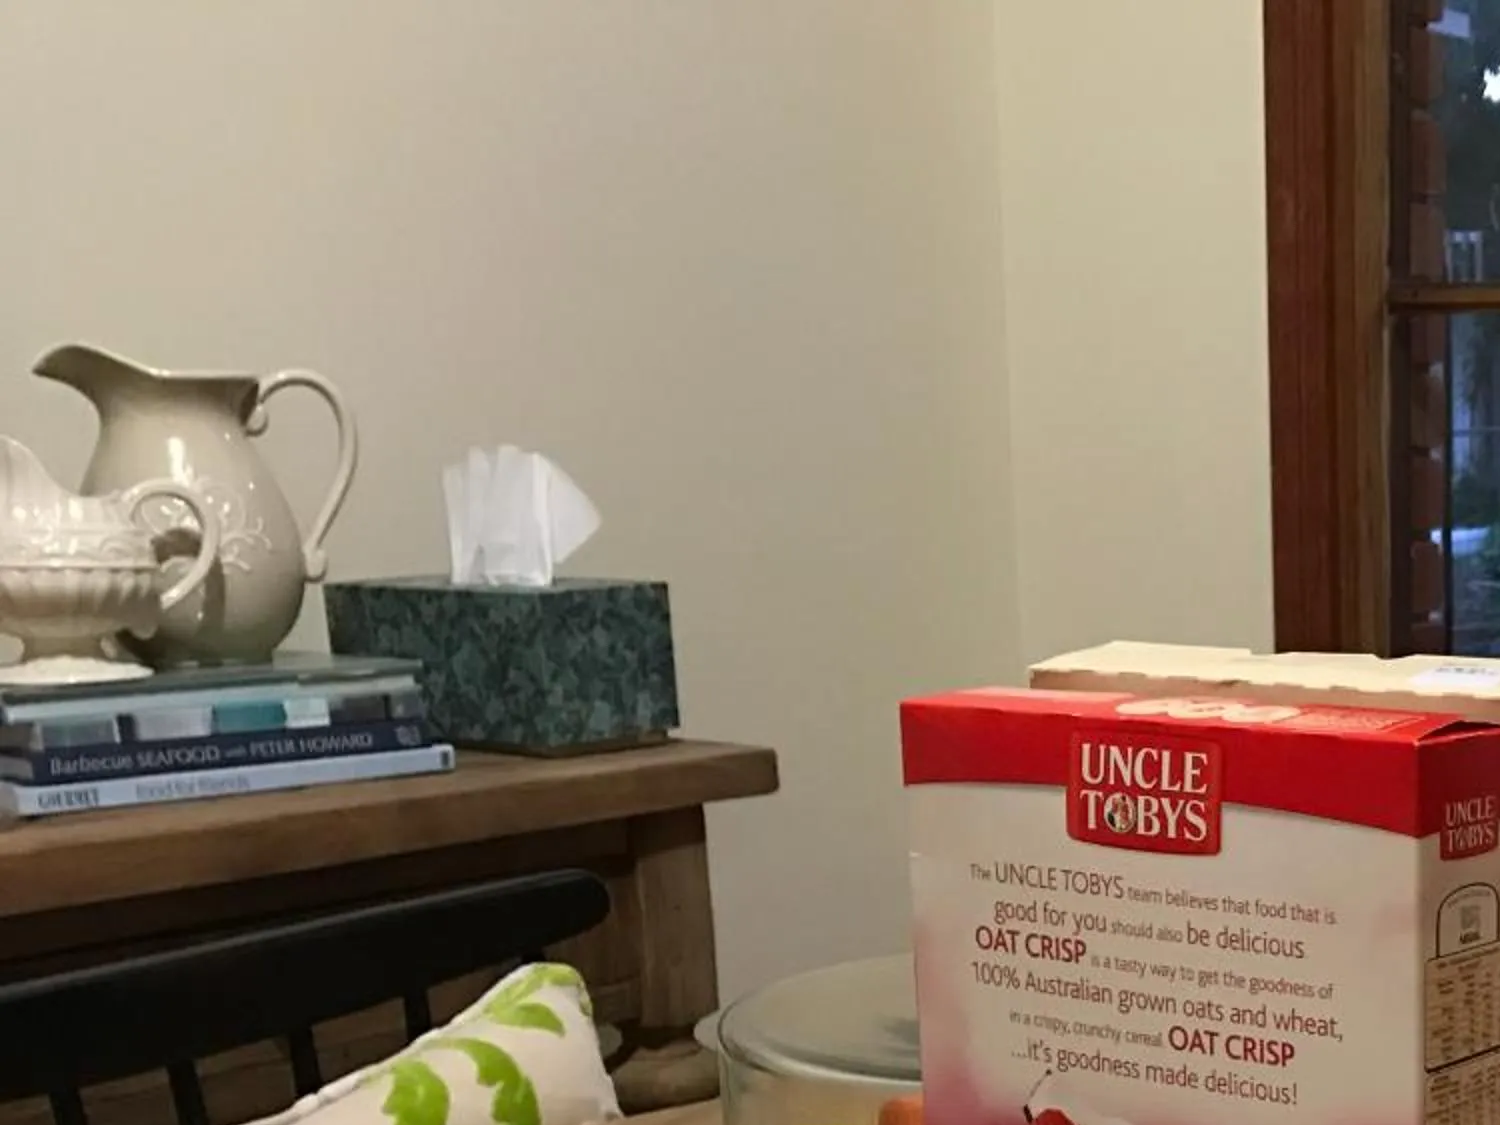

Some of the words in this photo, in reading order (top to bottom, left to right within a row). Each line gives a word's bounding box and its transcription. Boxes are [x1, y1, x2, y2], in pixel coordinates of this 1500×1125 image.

[50, 755, 132, 776] Barbecue
[136, 744, 221, 768] SEAFOOD
[250, 738, 295, 757] PETER
[299, 732, 374, 754] HOWARD
[1081, 743, 1209, 794] UNCLE
[1080, 789, 1208, 842] TOBYS
[1445, 795, 1497, 827] UNCLE
[1447, 821, 1496, 853] TOBYS
[970, 863, 992, 881] The
[995, 862, 1058, 891] UNCLE
[1060, 869, 1124, 899] TOBYS
[1128, 886, 1163, 905] team
[1165, 888, 1219, 912] believes
[1222, 896, 1251, 916] that
[1255, 899, 1287, 920] food
[1290, 903, 1320, 925] that
[1325, 910, 1337, 926] is
[994, 899, 1038, 926] good
[1043, 902, 1068, 927] for
[1072, 912, 1108, 936] you
[1111, 920, 1153, 939] should
[1157, 926, 1184, 944] also
[1186, 919, 1210, 947] be
[1216, 925, 1305, 959] delicious
[975, 925, 1022, 955] OAT
[1025, 933, 1088, 965] CRISP
[1114, 956, 1147, 980] tasty
[1150, 962, 1177, 984] way
[1179, 964, 1195, 981] to
[1198, 969, 1219, 989] get
[1223, 969, 1246, 989] the
[1248, 976, 1315, 998] goodness
[1316, 983, 1334, 1000] of
[971, 960, 1021, 990] 100%
[1024, 971, 1113, 1005] Australian
[1117, 989, 1177, 1015] grown
[1183, 998, 1225, 1022] oats
[1229, 1004, 1267, 1028] and
[1272, 1007, 1343, 1042] wheat,
[1072, 1021, 1121, 1045] crunchy
[1168, 1025, 1219, 1056] OAT
[1224, 1034, 1295, 1068] CRISP
[1057, 1049, 1141, 1079] goodness
[1146, 1063, 1199, 1089] made
[1204, 1068, 1298, 1106] delicious!
